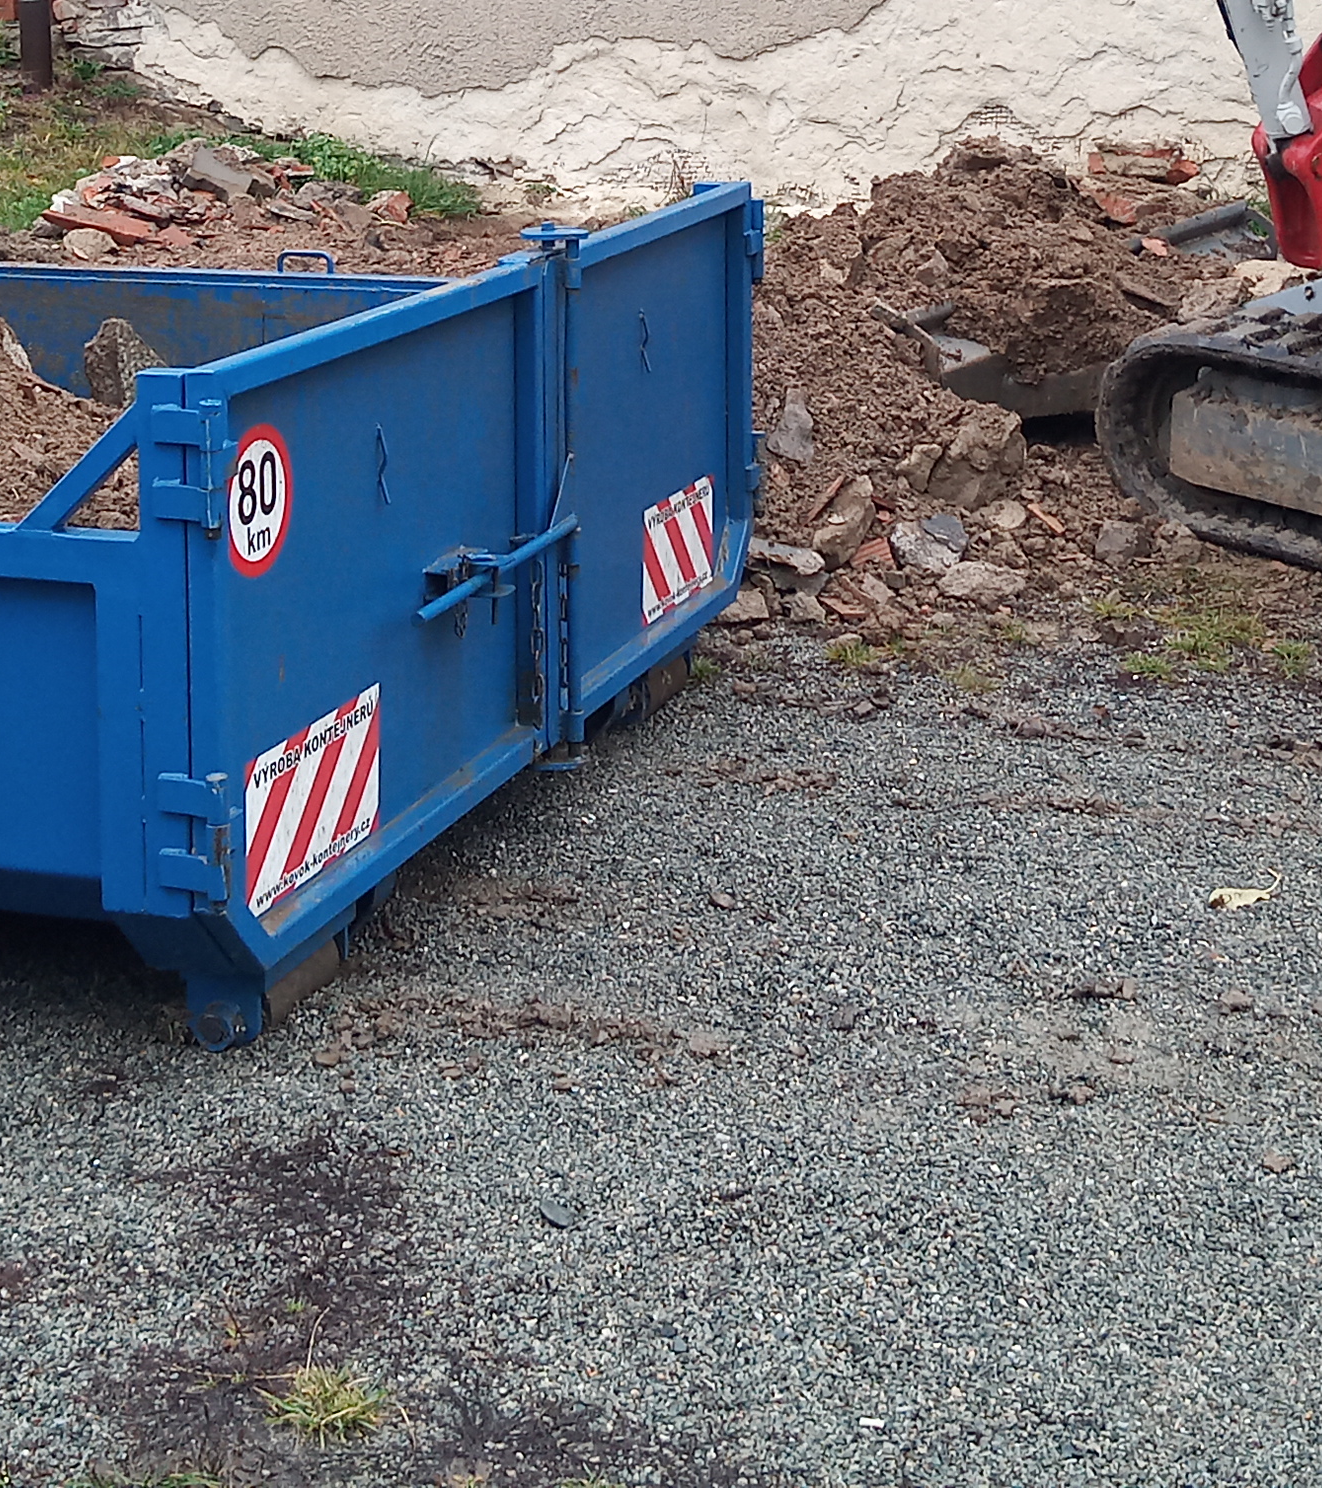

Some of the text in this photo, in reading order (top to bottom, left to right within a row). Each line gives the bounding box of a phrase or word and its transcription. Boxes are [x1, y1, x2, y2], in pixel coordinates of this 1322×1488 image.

[237, 450, 278, 526] 80
[247, 525, 272, 557] km
[254, 817, 372, 908] www.kovok-kontejnery.cz
